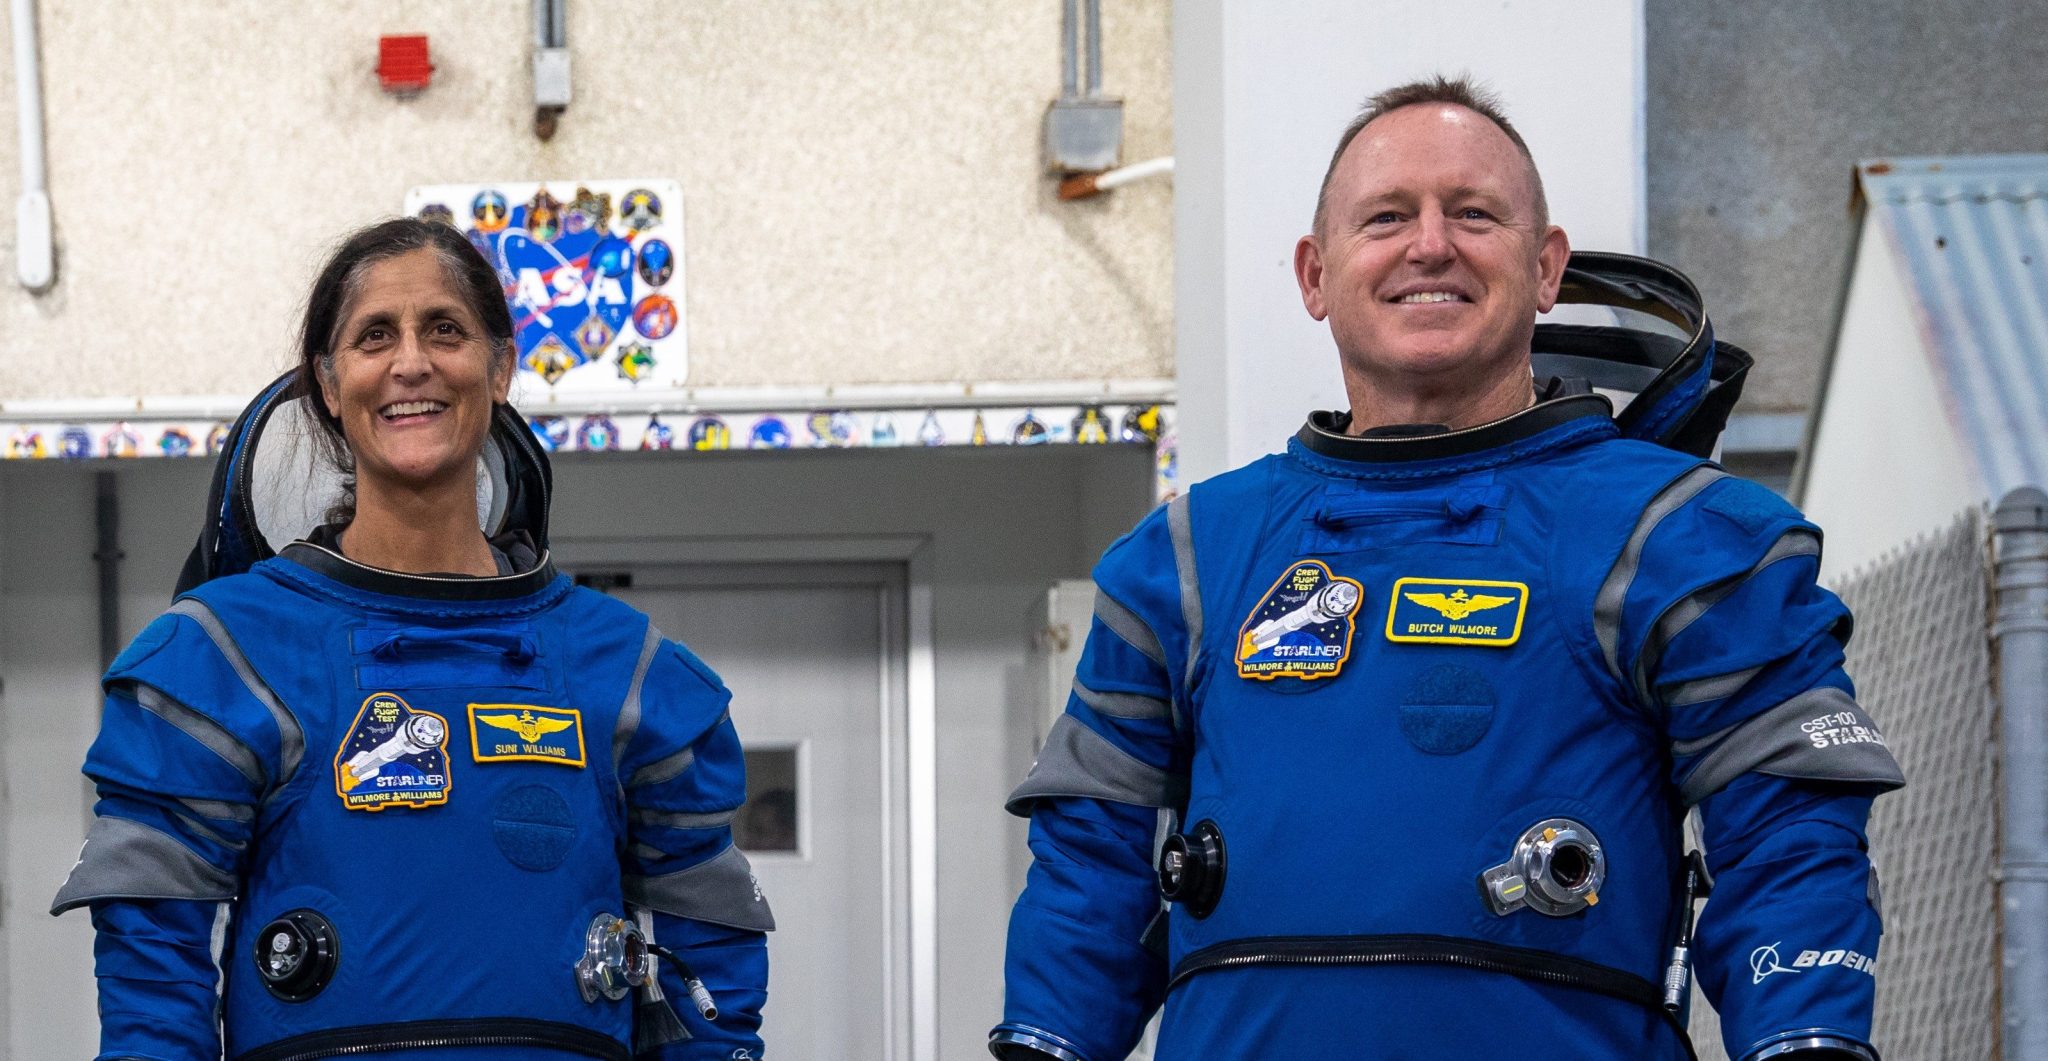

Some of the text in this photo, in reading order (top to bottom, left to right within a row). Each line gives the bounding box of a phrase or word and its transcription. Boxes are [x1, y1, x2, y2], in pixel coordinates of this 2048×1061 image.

[515, 267, 626, 306] ASA
[1295, 568, 1320, 576] CREW
[1293, 583, 1315, 591] TEST
[1408, 623, 1498, 635] BUTCH WILMORE
[1273, 645, 1342, 657] STARLINER
[1243, 662, 1336, 672] WILMORE WILLIAMS
[1800, 711, 1857, 733] CST-100
[495, 744, 566, 757] SUNI WILLIAMS
[376, 774, 445, 787] STARLINER
[349, 791, 443, 804] WILMORE WILLIAMS
